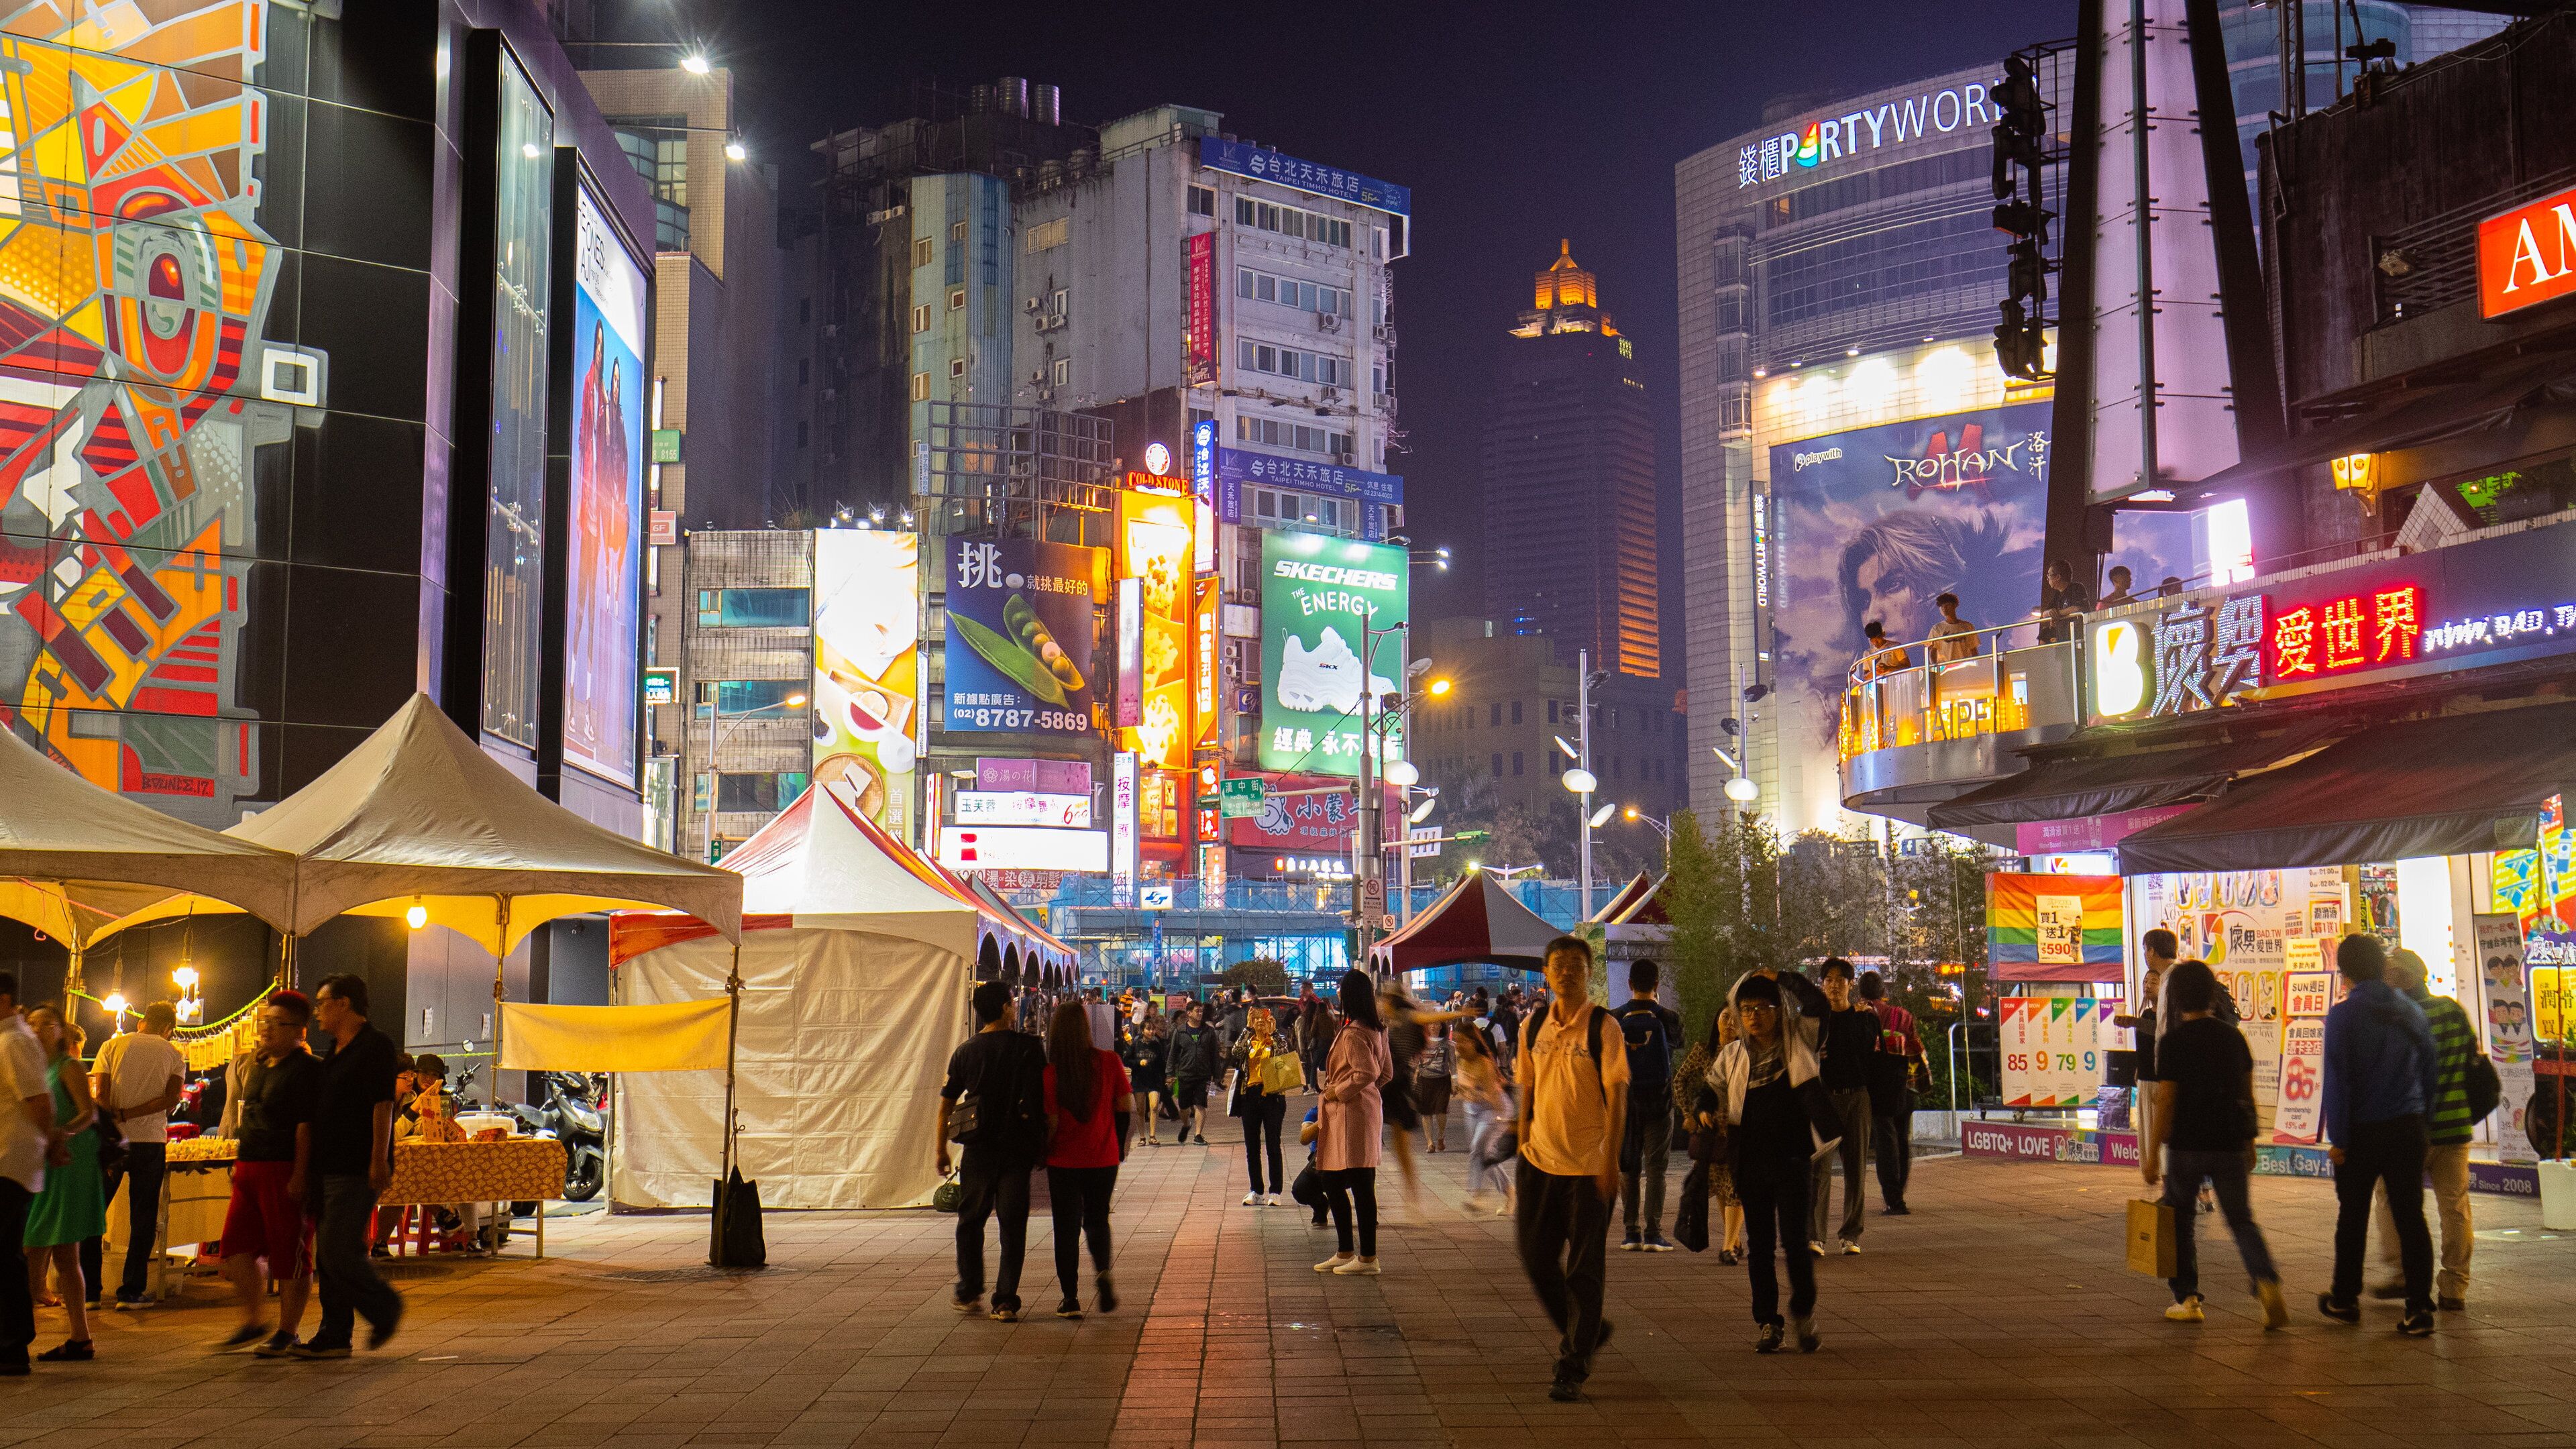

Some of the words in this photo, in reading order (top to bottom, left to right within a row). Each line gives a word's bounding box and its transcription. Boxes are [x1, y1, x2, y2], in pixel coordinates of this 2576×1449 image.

[1739, 136, 1780, 189] 錢櫃
[1269, 155, 1359, 193] 台北天禾旅店
[1275, 174, 1299, 185] TAIPEI
[1301, 180, 1326, 192] TIMHO
[1329, 187, 1354, 199] HOTEL
[1805, 447, 1842, 464] playwith
[1883, 439, 2026, 492] ROHAN
[2028, 430, 2051, 482] 洛汗
[1267, 459, 1344, 485] 台北天禾旅店
[1128, 471, 1155, 488] COLD
[1155, 475, 1189, 496] STONE
[1271, 476, 1293, 485] TAIPEI
[1294, 480, 1315, 490] TIMHO
[1316, 483, 1336, 492] HOTEL
[1381, 482, 1393, 494] 住宿
[1227, 482, 1235, 518] 天禾旅店
[653, 524, 667, 532] 6F
[957, 541, 1003, 589] 挑
[1026, 574, 1088, 596] 就挑最好的
[1274, 560, 1398, 592] SKECHERS
[1291, 587, 1305, 598] THE
[1300, 590, 1379, 622] ENERGY
[2275, 586, 2419, 679] 愛世界
[2150, 594, 2264, 718] 壞男
[953, 708, 1087, 731] (02)8787-5869
[1917, 695, 1997, 747] TAIPEI
[1273, 726, 1313, 753] 經典
[999, 769, 1032, 784] 湯の花
[1225, 780, 1259, 793] 漢中街
[1118, 775, 1130, 809] 按摩
[961, 798, 996, 813] 玉芙蓉
[1300, 826, 1354, 838] 頂級麻辣
[1040, 914, 1046, 929] 6
[2041, 912, 2058, 924] 買1
[2314, 906, 2337, 920] 潤滑液
[2046, 925, 2065, 938] 送1
[2256, 929, 2282, 938] BAD.TW
[2314, 922, 2339, 934] 買1送1
[2229, 922, 2255, 955] 壞男
[2257, 939, 2283, 953] 愛世界
[2041, 943, 2071, 955] $590
[2293, 995, 2323, 1012] 會員日
[2289, 1027, 2323, 1038] 會員回娘家
[2008, 1054, 2028, 1071] 85
[2036, 1050, 2049, 1071] 9
[2056, 1053, 2077, 1071] 79
[2084, 1051, 2096, 1071] 9
[2285, 1056, 2316, 1101] 85
[1968, 1131, 2013, 1151] LGBTQ+
[2019, 1136, 2050, 1156] LOVE
[2261, 1155, 2292, 1174] Best
[2479, 1179, 2501, 1191] Since
[2502, 1177, 2532, 1193] 2008
